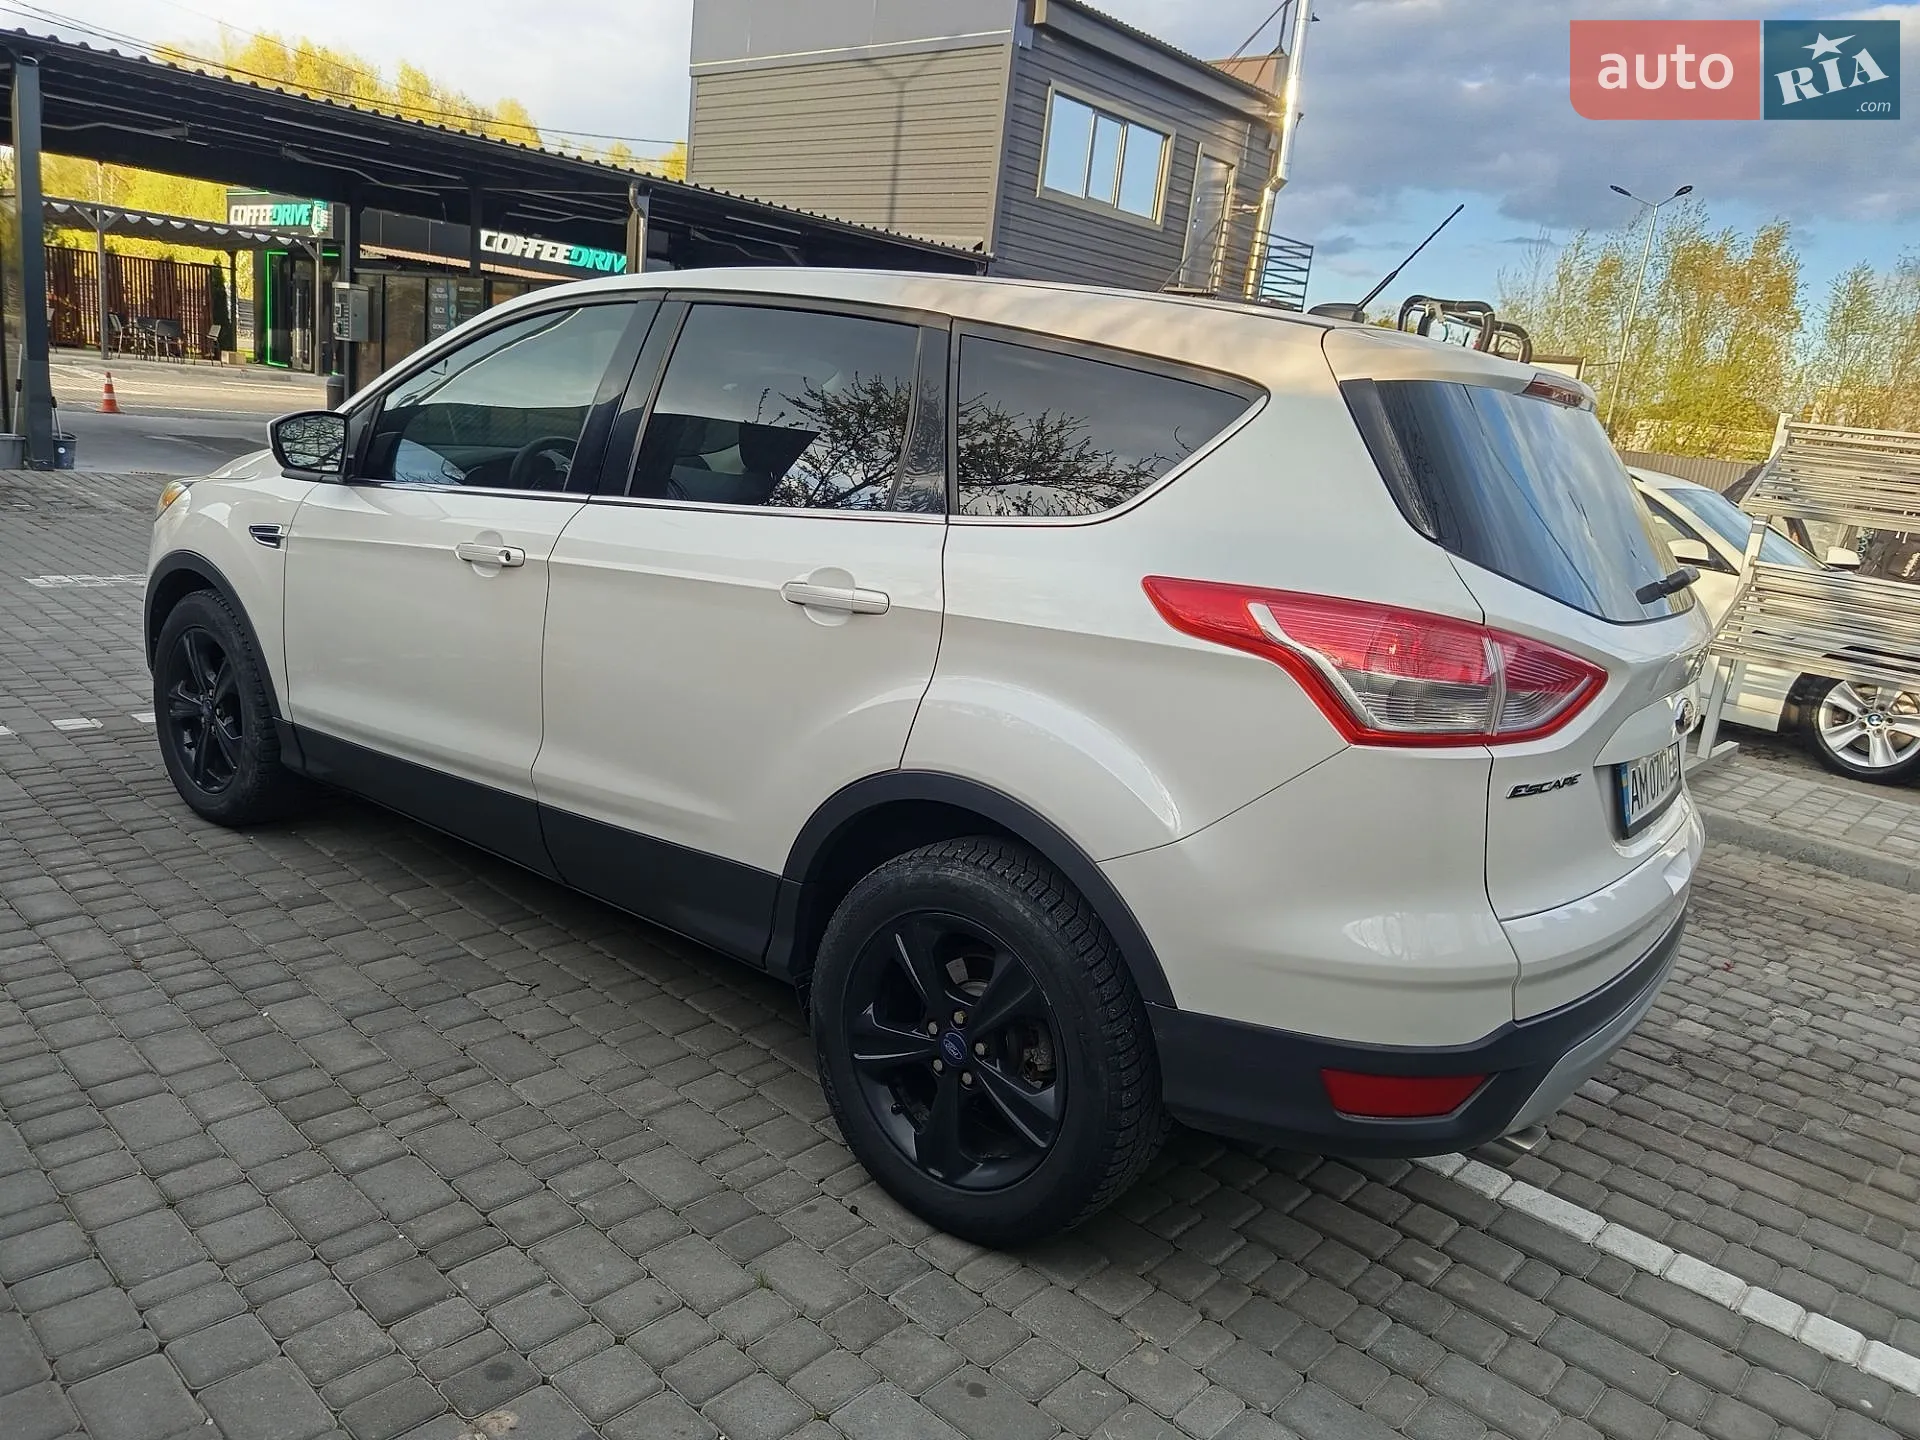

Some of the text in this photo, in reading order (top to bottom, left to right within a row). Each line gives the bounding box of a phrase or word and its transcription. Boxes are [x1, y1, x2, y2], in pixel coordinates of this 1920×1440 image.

[229, 203, 312, 226] COFFEEDRIVE
[479, 229, 627, 274] COFFEEDRIV
[1506, 773, 1582, 799] ESCAPE
